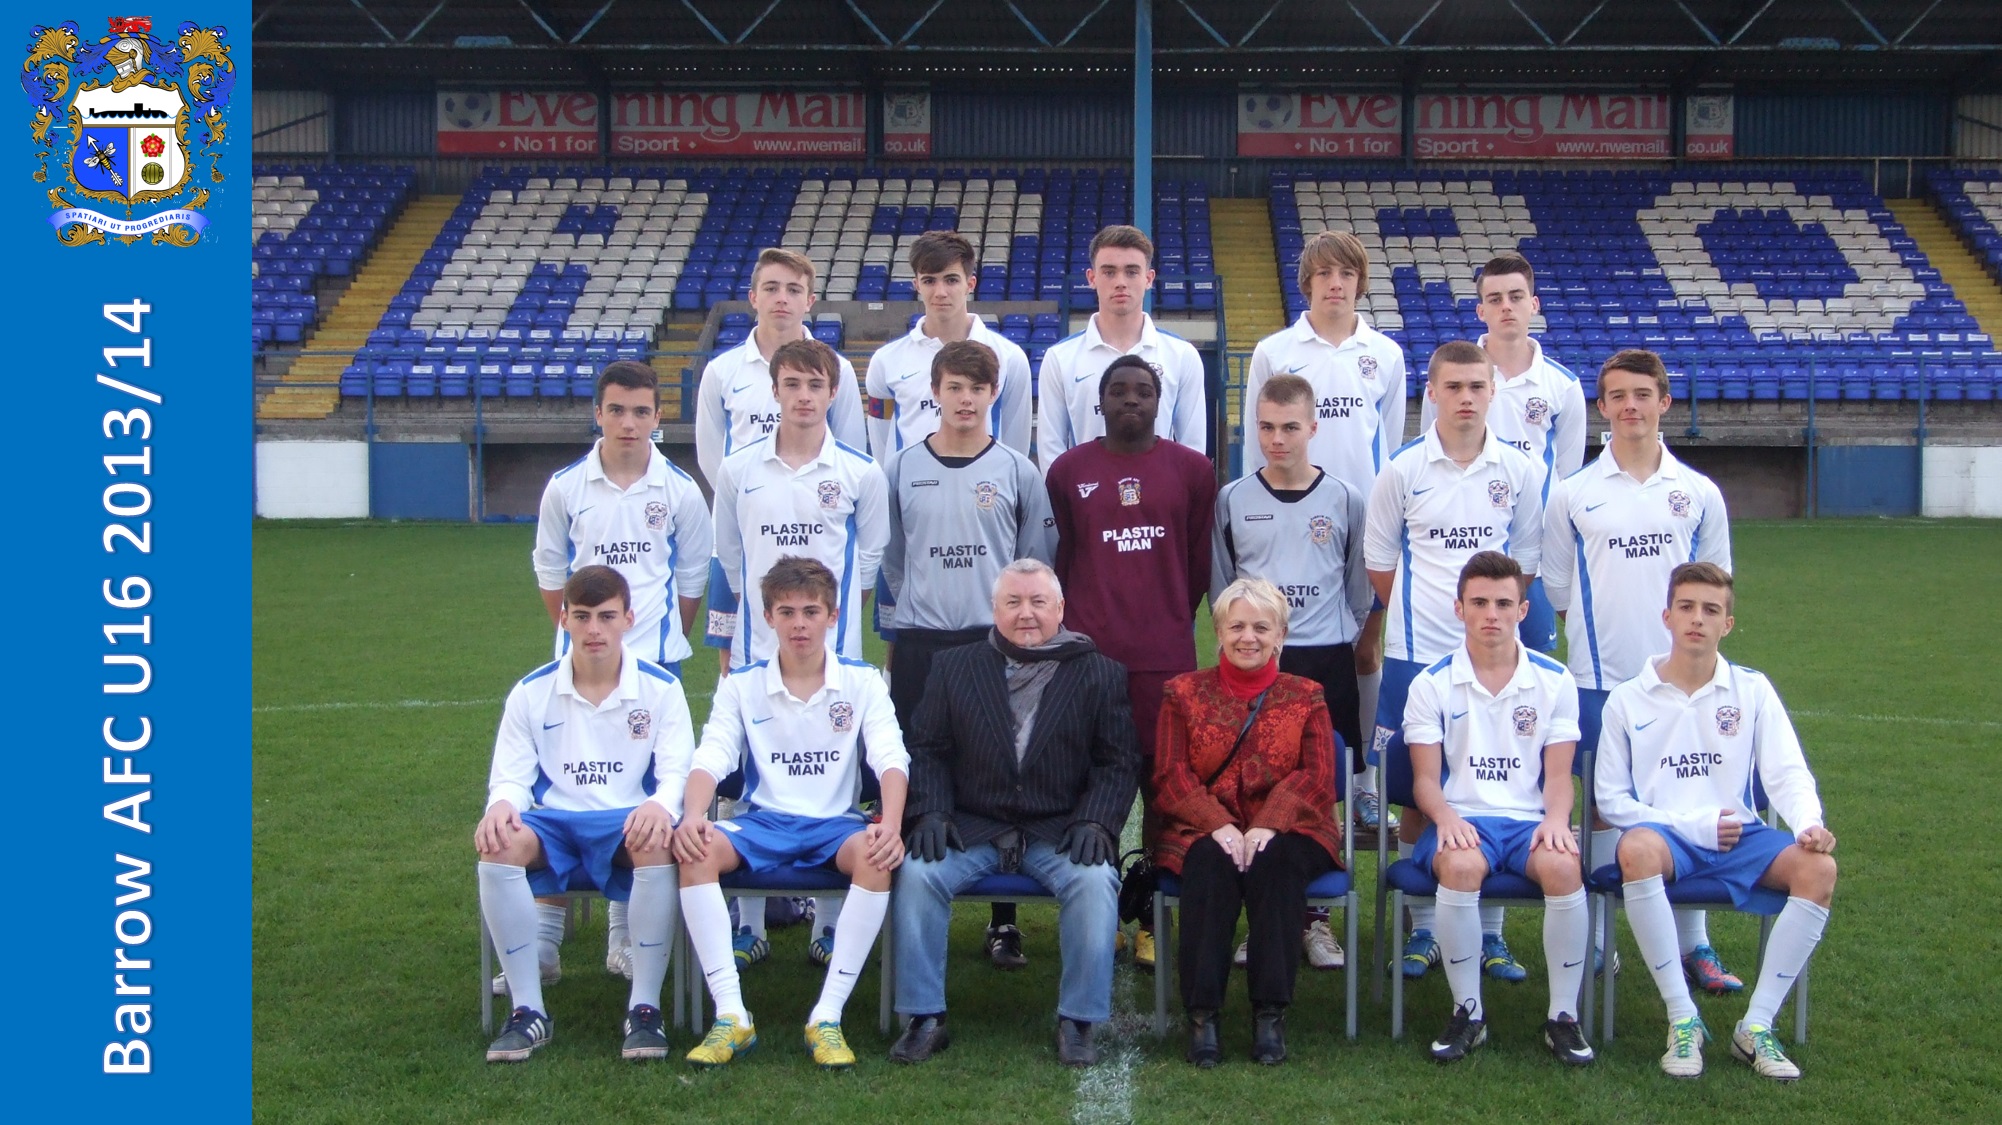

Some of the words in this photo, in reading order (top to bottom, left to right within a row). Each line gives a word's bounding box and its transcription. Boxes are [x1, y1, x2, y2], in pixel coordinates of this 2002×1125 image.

[752, 89, 866, 127] Mail
[1555, 92, 1669, 129] Mail
[514, 136, 543, 151] No
[548, 137, 556, 151] 1
[565, 136, 597, 151] for
[618, 136, 680, 153] Sport
[1309, 138, 1339, 153] No
[1345, 139, 1354, 153] 1
[1363, 138, 1392, 153] for
[1417, 138, 1479, 154] Sport
[1315, 397, 1364, 408] LASTIC
[749, 412, 781, 424] PLAS
[1319, 408, 1350, 419] MAN
[762, 523, 823, 536] PLASTIC
[1102, 525, 1165, 542] PLASTIC
[1429, 526, 1493, 540] PLASTIC
[776, 534, 809, 546] MAN
[1117, 538, 1152, 552] MAN
[1445, 537, 1479, 549] MAN
[1608, 533, 1673, 549] PLASTIC
[594, 541, 651, 556] PLASTIC
[930, 545, 987, 558] PLASTIC
[1625, 545, 1660, 558] MAN
[605, 553, 637, 565] MAN
[942, 557, 973, 569] MAN
[1278, 585, 1320, 596] ASTIC
[1287, 597, 1305, 608] AN
[771, 750, 840, 764] PLASTIC
[1469, 757, 1521, 769] LASTIC
[1660, 752, 1723, 769] PLASTIC
[563, 761, 624, 775] PLASTIC
[788, 763, 825, 776] MAN
[1676, 764, 1709, 779] MAN
[575, 772, 608, 786] MAN
[1476, 769, 1508, 782] MAN
